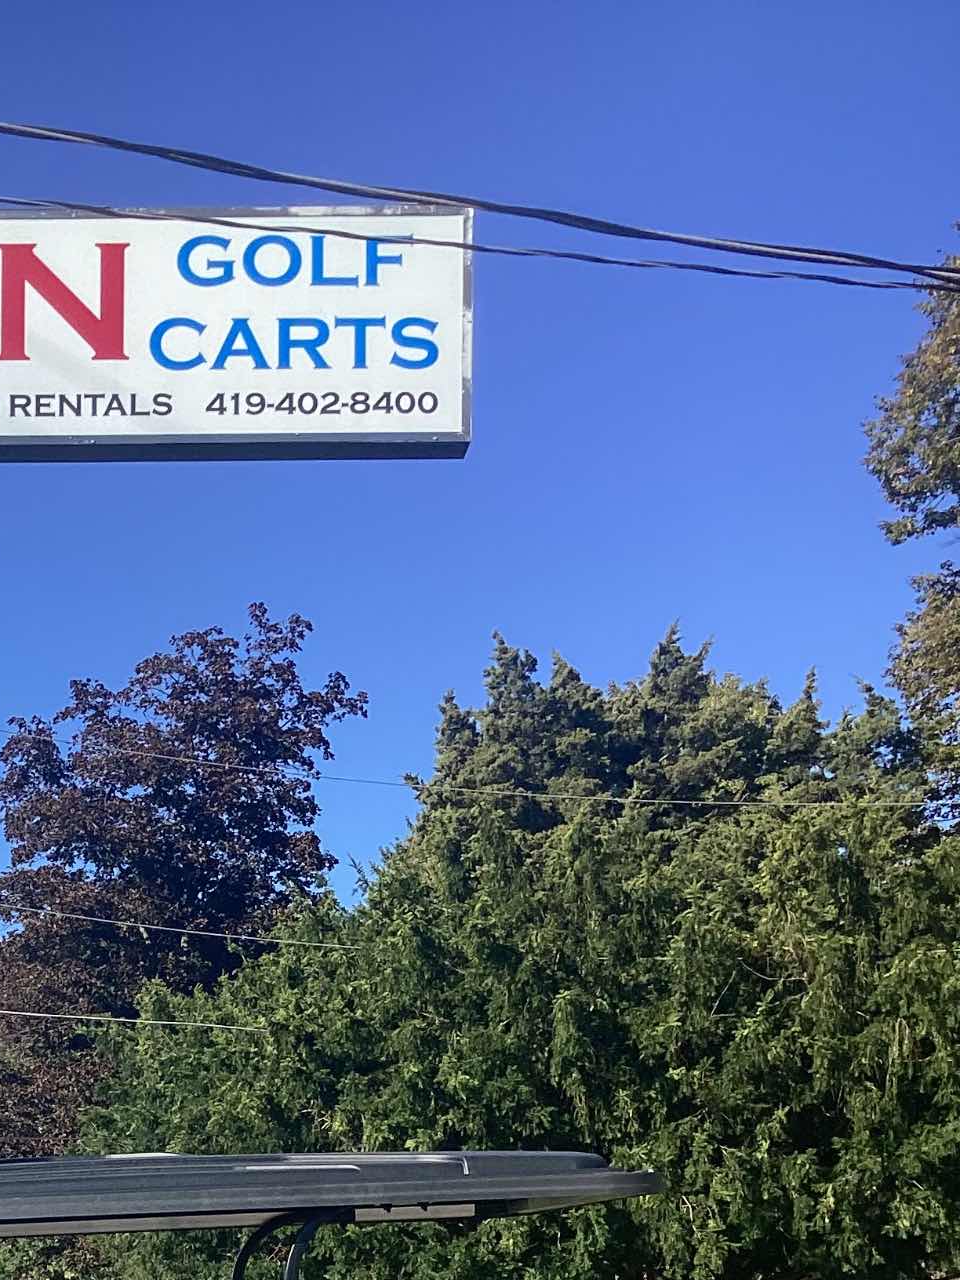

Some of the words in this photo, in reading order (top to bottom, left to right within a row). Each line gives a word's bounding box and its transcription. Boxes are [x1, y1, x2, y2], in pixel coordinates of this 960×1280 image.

[176, 234, 414, 288] GOLF
[148, 315, 440, 371] CARTS
[9, 393, 173, 417] RENTALS
[205, 391, 439, 415] 419-402-8400
